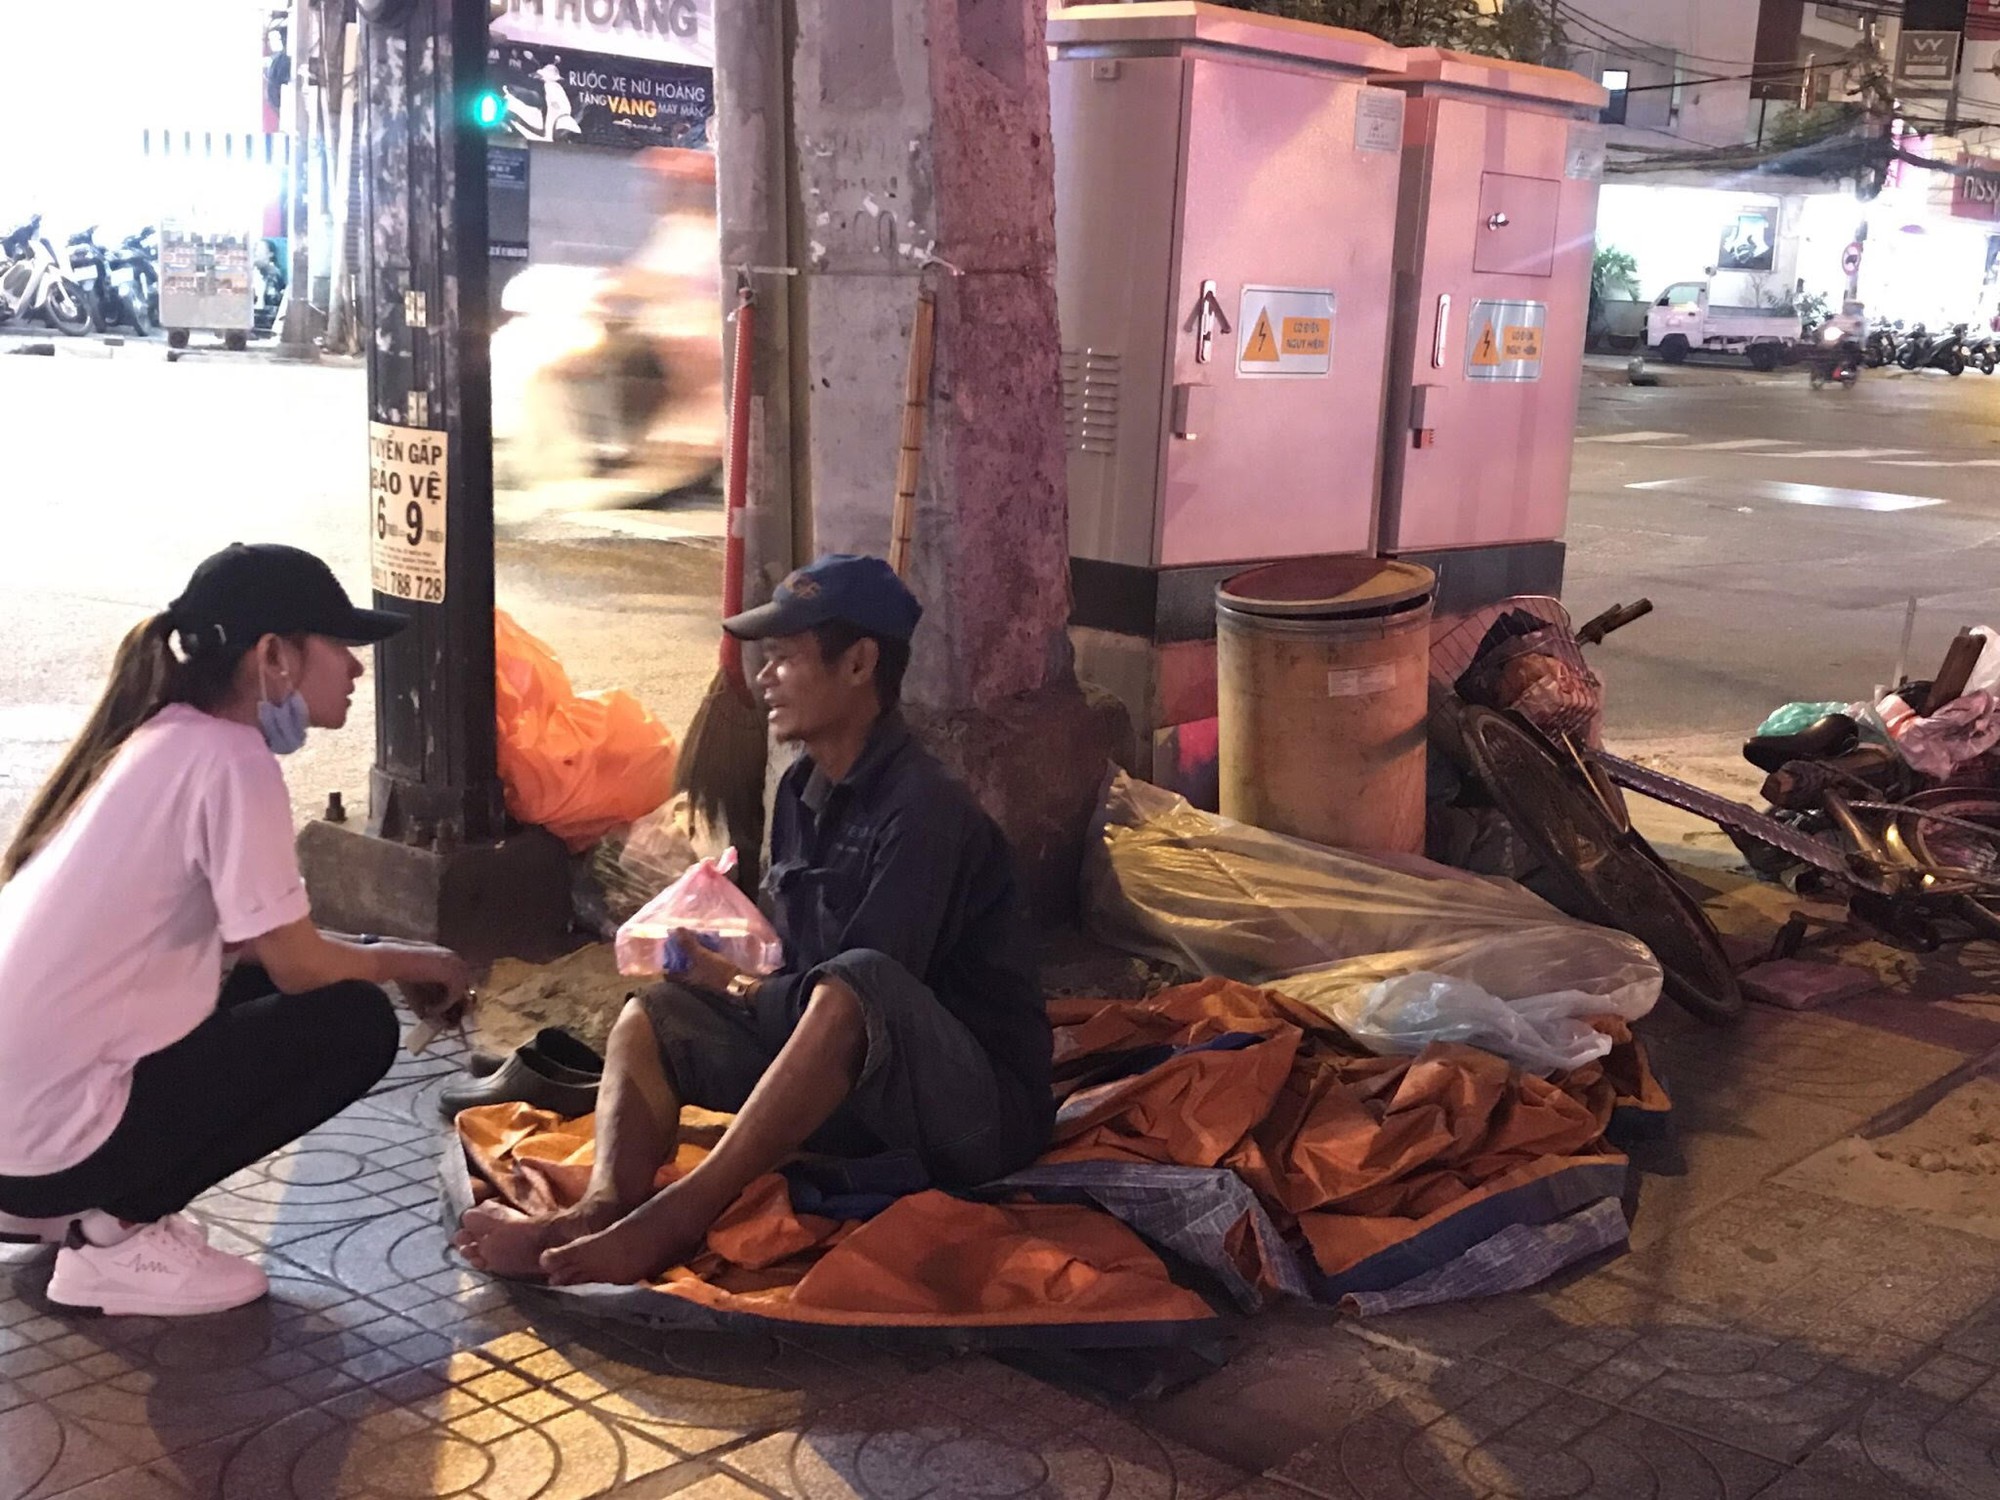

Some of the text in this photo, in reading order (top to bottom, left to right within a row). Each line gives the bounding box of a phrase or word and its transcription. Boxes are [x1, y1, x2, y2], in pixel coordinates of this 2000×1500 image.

[607, 93, 657, 118] VÀNG
[655, 81, 706, 102] HOÀNG
[408, 436, 442, 465] GẤP
[371, 461, 441, 504] BẢO VỆ
[377, 495, 423, 546] 6 9
